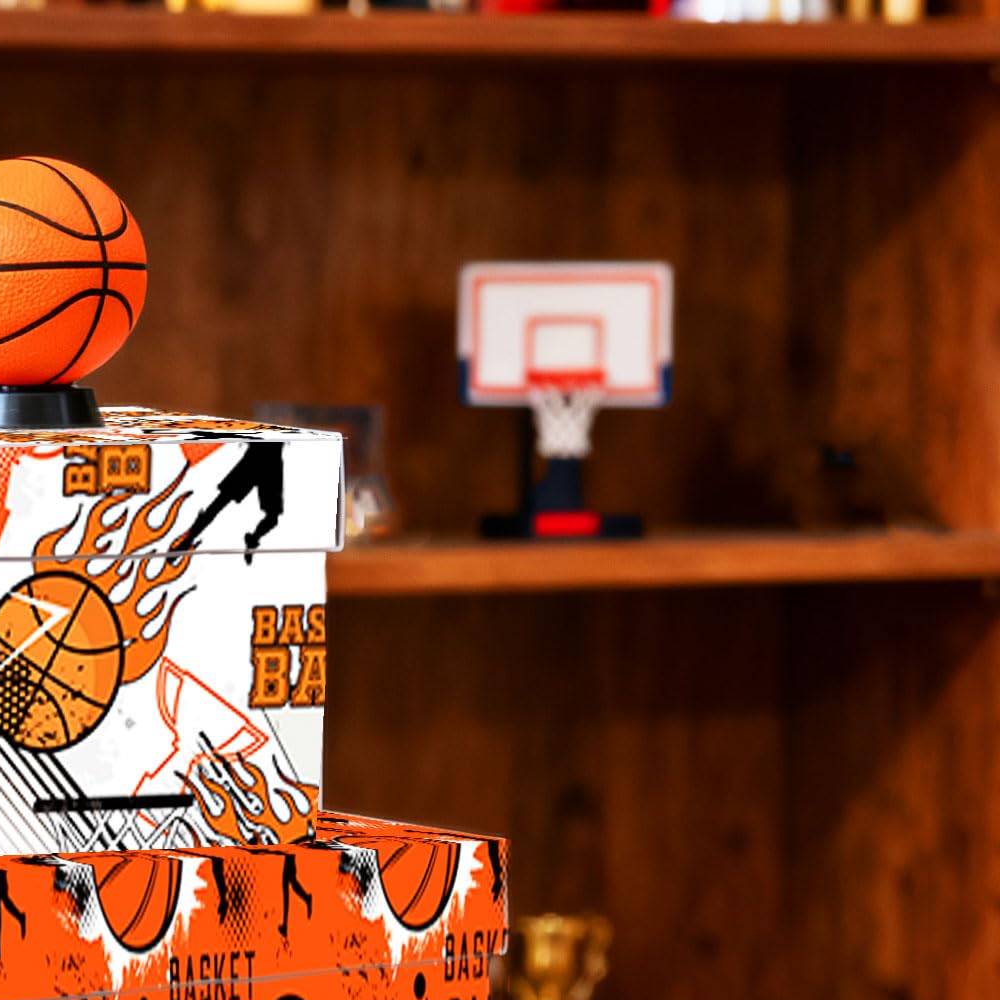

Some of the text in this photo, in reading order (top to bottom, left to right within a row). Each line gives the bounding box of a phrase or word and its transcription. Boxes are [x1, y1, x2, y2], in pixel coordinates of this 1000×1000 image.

[251, 604, 326, 646] BAS
[248, 645, 326, 708] BA
[445, 929, 509, 982] BASK
